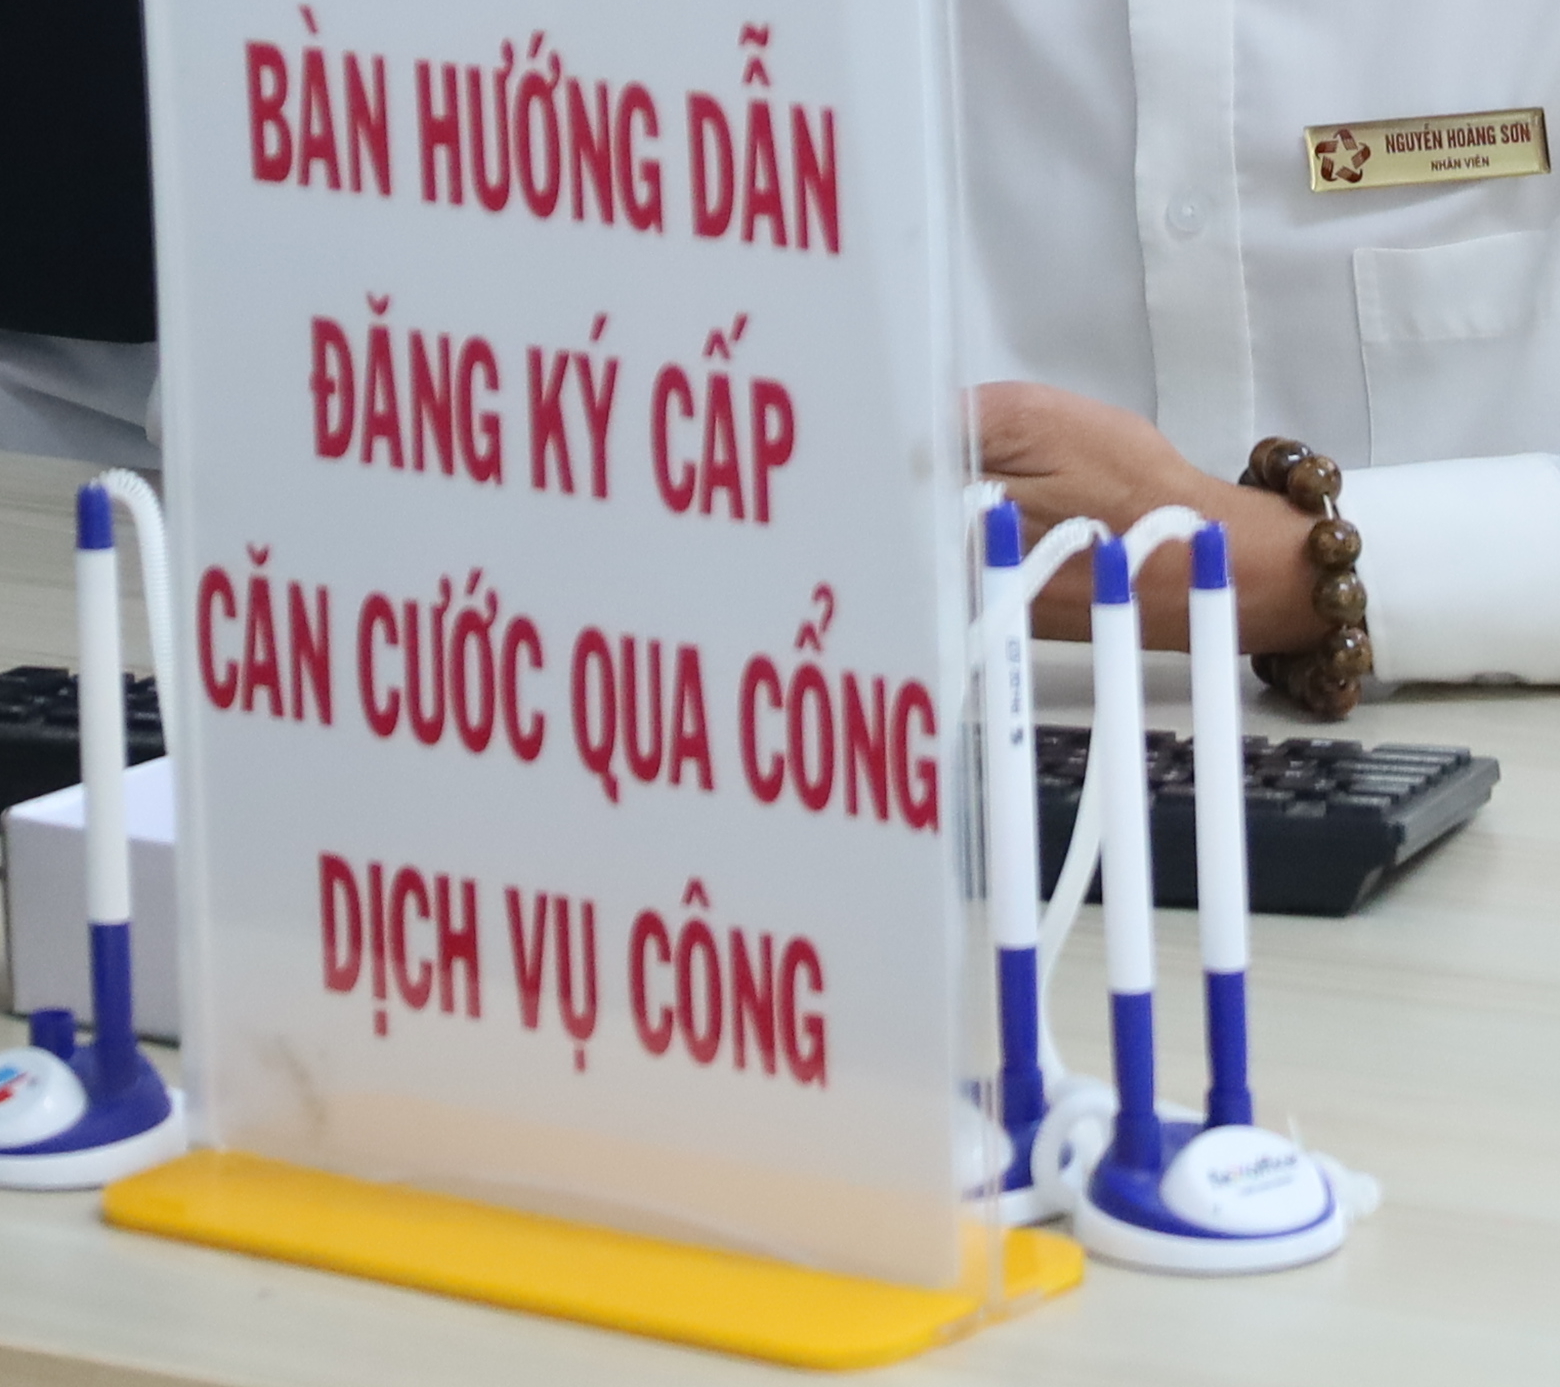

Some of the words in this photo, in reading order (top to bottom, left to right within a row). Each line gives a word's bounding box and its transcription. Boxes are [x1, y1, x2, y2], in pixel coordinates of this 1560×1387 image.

[244, 3, 393, 199] BÀN
[414, 29, 666, 236] HƯỚNG
[686, 21, 842, 258] DẪN
[1430, 157, 1462, 171] NHÂN
[1464, 154, 1490, 168] VIÊN
[1446, 123, 1497, 148] HOÀNG
[1499, 122, 1531, 144] SƠN
[308, 289, 504, 487] ĐĂNG
[526, 311, 620, 501] KÝ
[648, 311, 797, 527] CẤP
[196, 540, 334, 728] CĂN
[355, 566, 545, 764] CƯỚC
[569, 623, 716, 807] QUA
[736, 580, 942, 835] CỔNG
[318, 849, 483, 1038] DỊCH
[502, 884, 599, 1074] VỤ
[626, 875, 828, 1092] CÔNG
